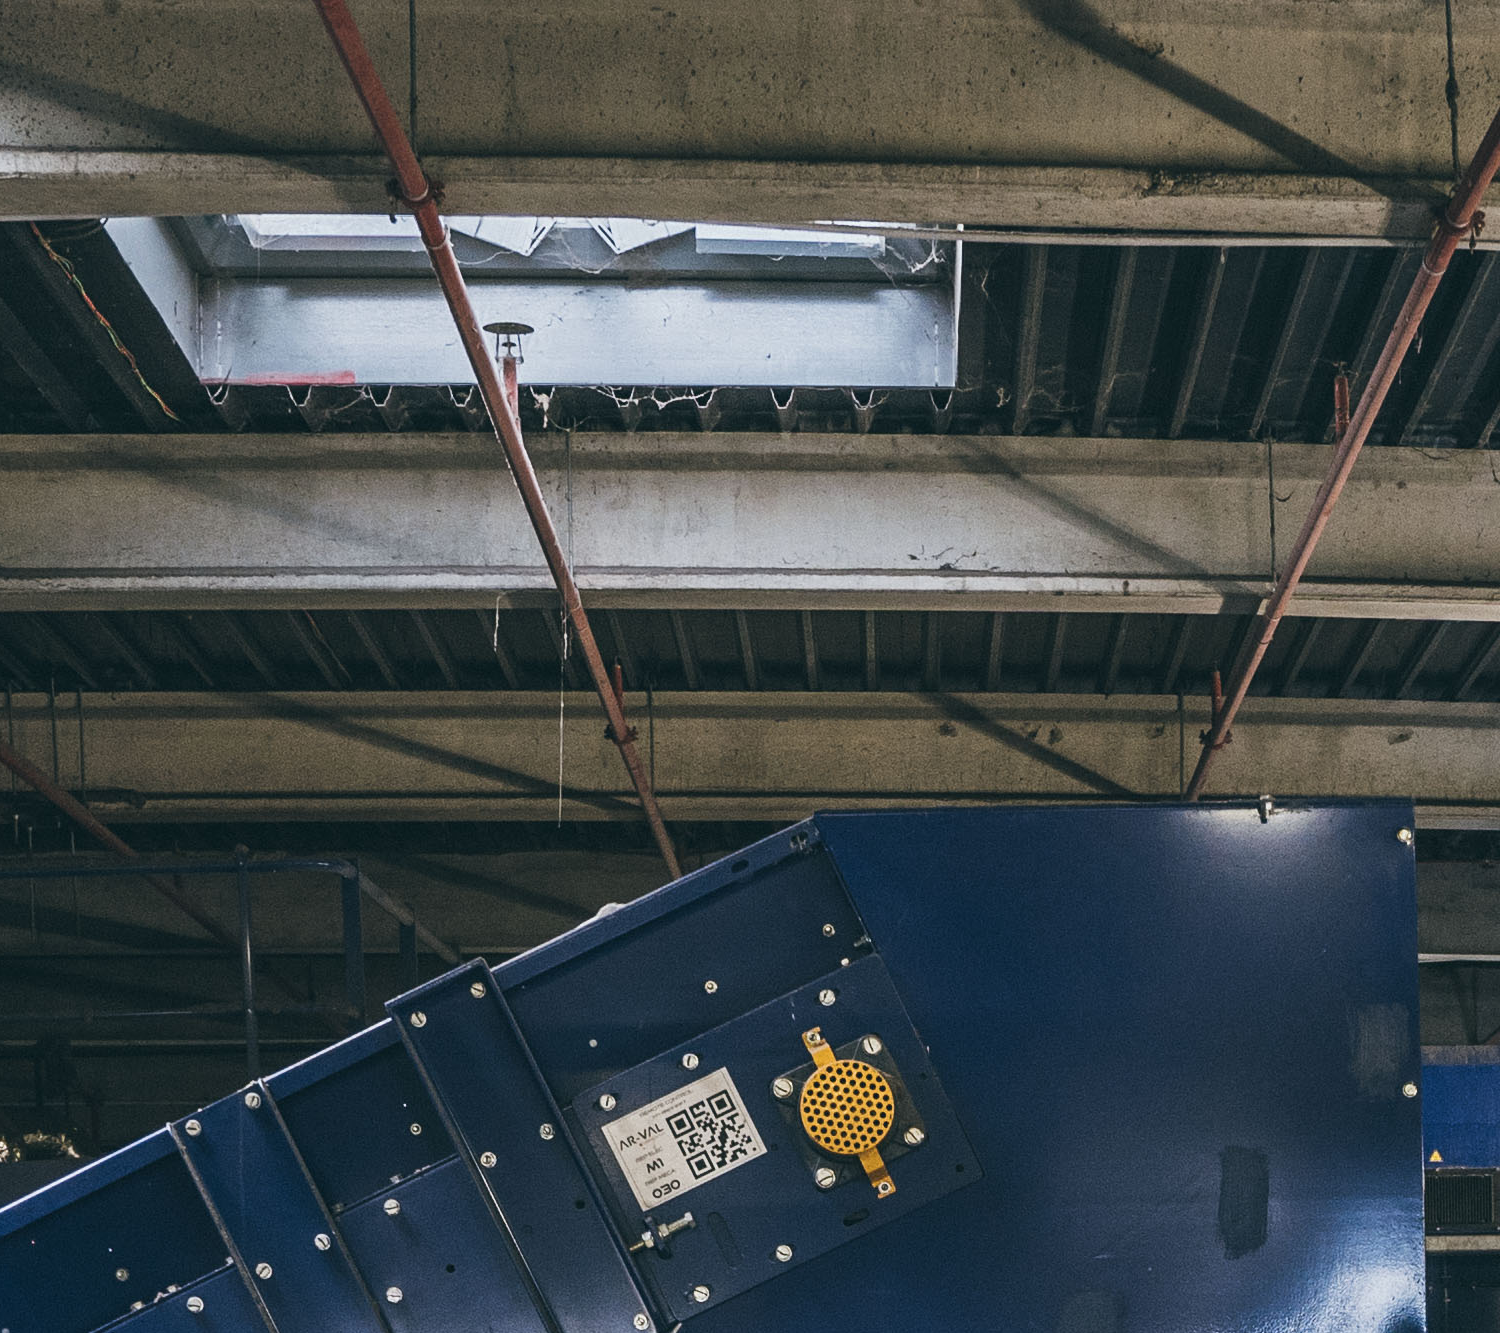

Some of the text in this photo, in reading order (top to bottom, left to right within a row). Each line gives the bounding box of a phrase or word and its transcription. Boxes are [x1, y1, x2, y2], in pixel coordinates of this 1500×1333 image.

[619, 1123, 664, 1151] AR-VAL
[646, 1157, 664, 1174] M1
[652, 1179, 681, 1199] 030
